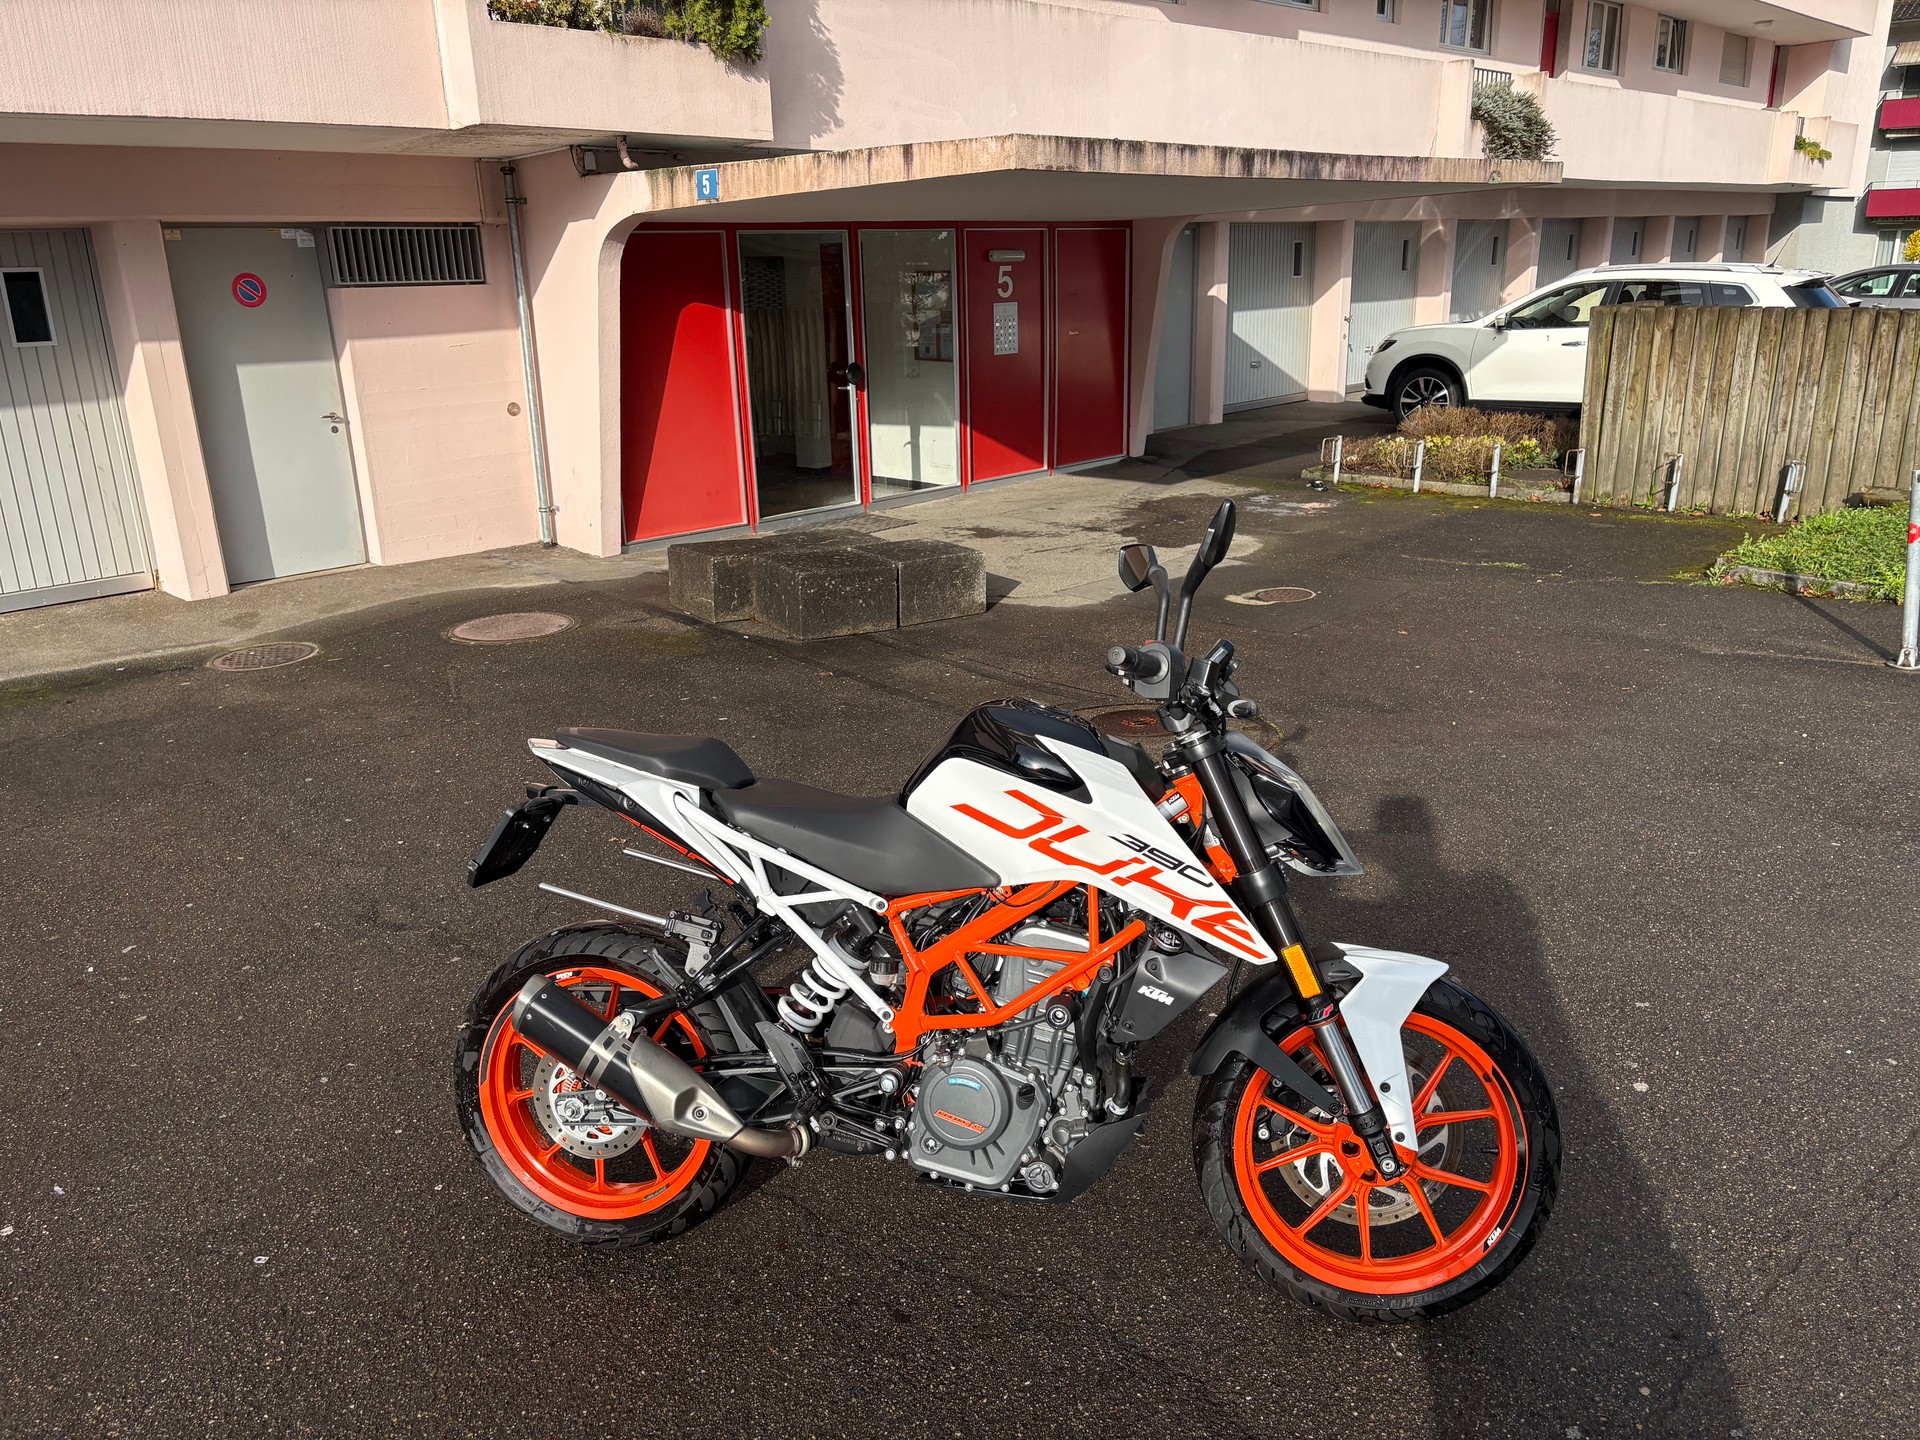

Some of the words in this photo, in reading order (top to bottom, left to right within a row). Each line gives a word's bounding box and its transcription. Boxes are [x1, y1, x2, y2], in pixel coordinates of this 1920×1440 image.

[702, 174, 710, 195] 5
[997, 265, 1014, 298] 5
[1108, 833, 1214, 888] 390
[949, 789, 1269, 960] DUKE
[1137, 985, 1175, 1006] KTM
[1486, 1226, 1502, 1247] KTM
